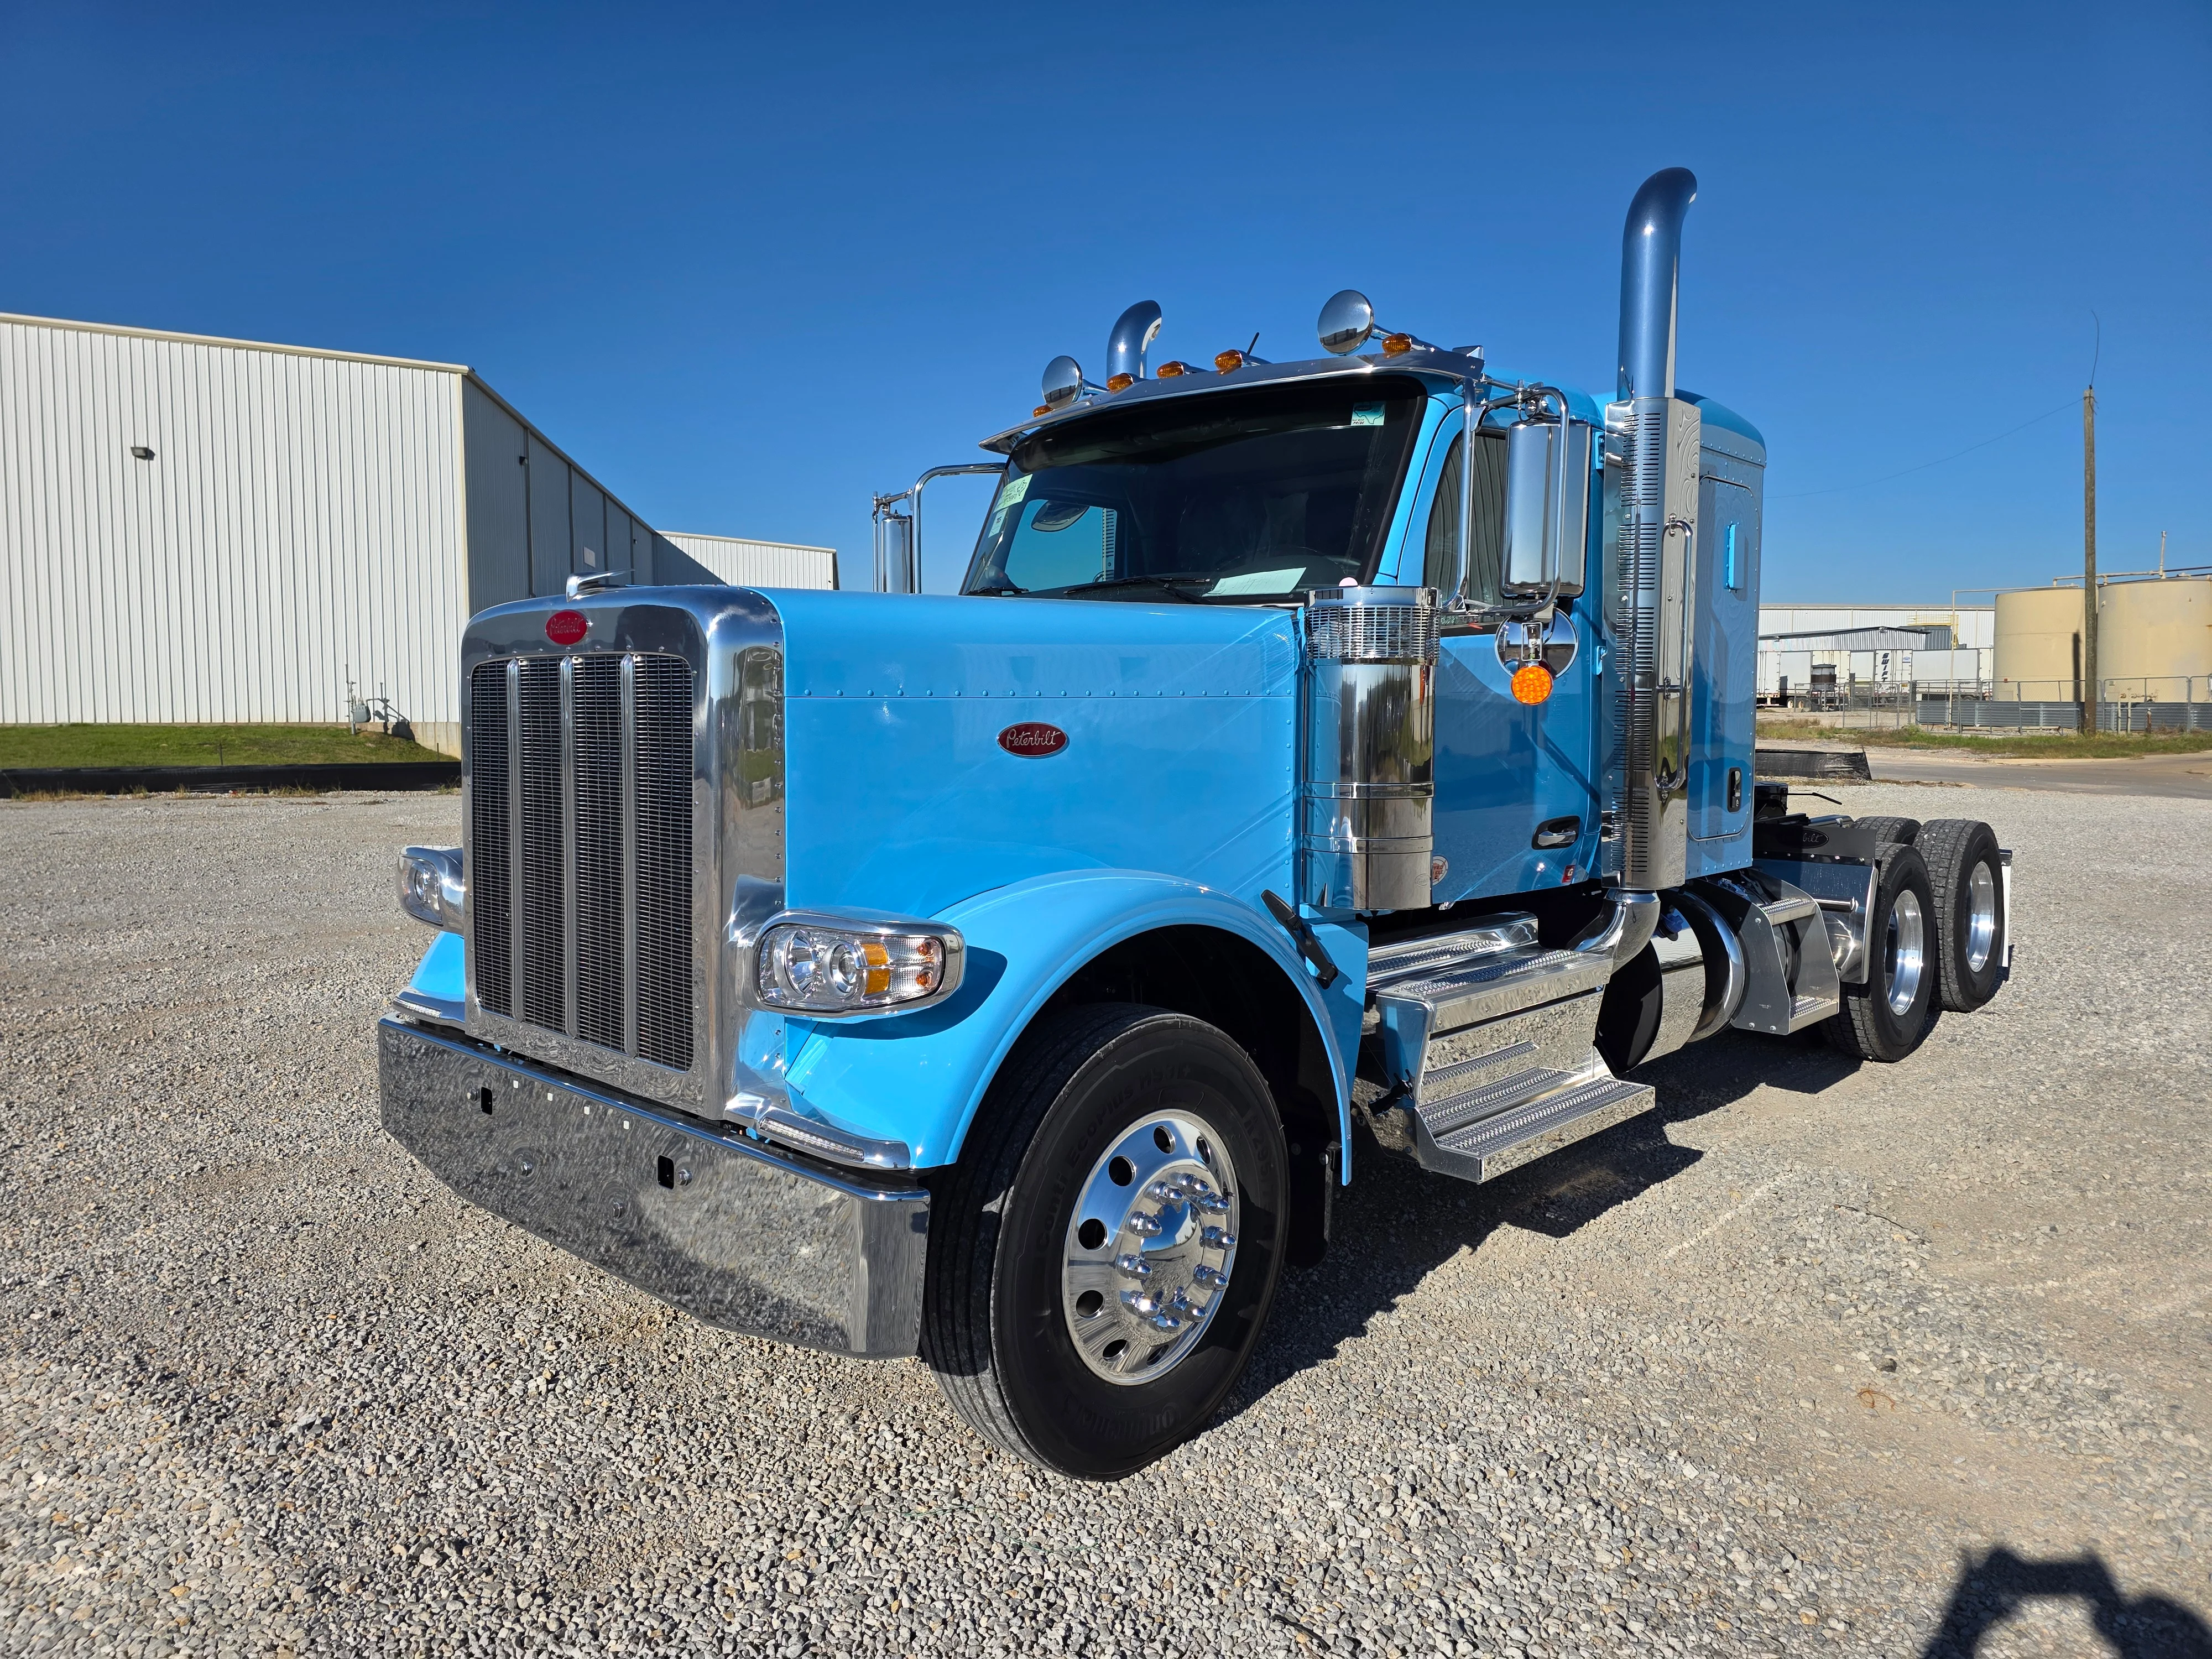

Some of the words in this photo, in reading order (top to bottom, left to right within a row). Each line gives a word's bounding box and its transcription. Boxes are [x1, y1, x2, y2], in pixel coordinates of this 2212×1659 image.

[550, 617, 583, 637] Peterbilt
[1881, 653, 1890, 682] SWIFT
[1006, 729, 1061, 748] Peterbilt
[1036, 1171, 1068, 1252] Conti
[1065, 1083, 1133, 1169] EcoPlus
